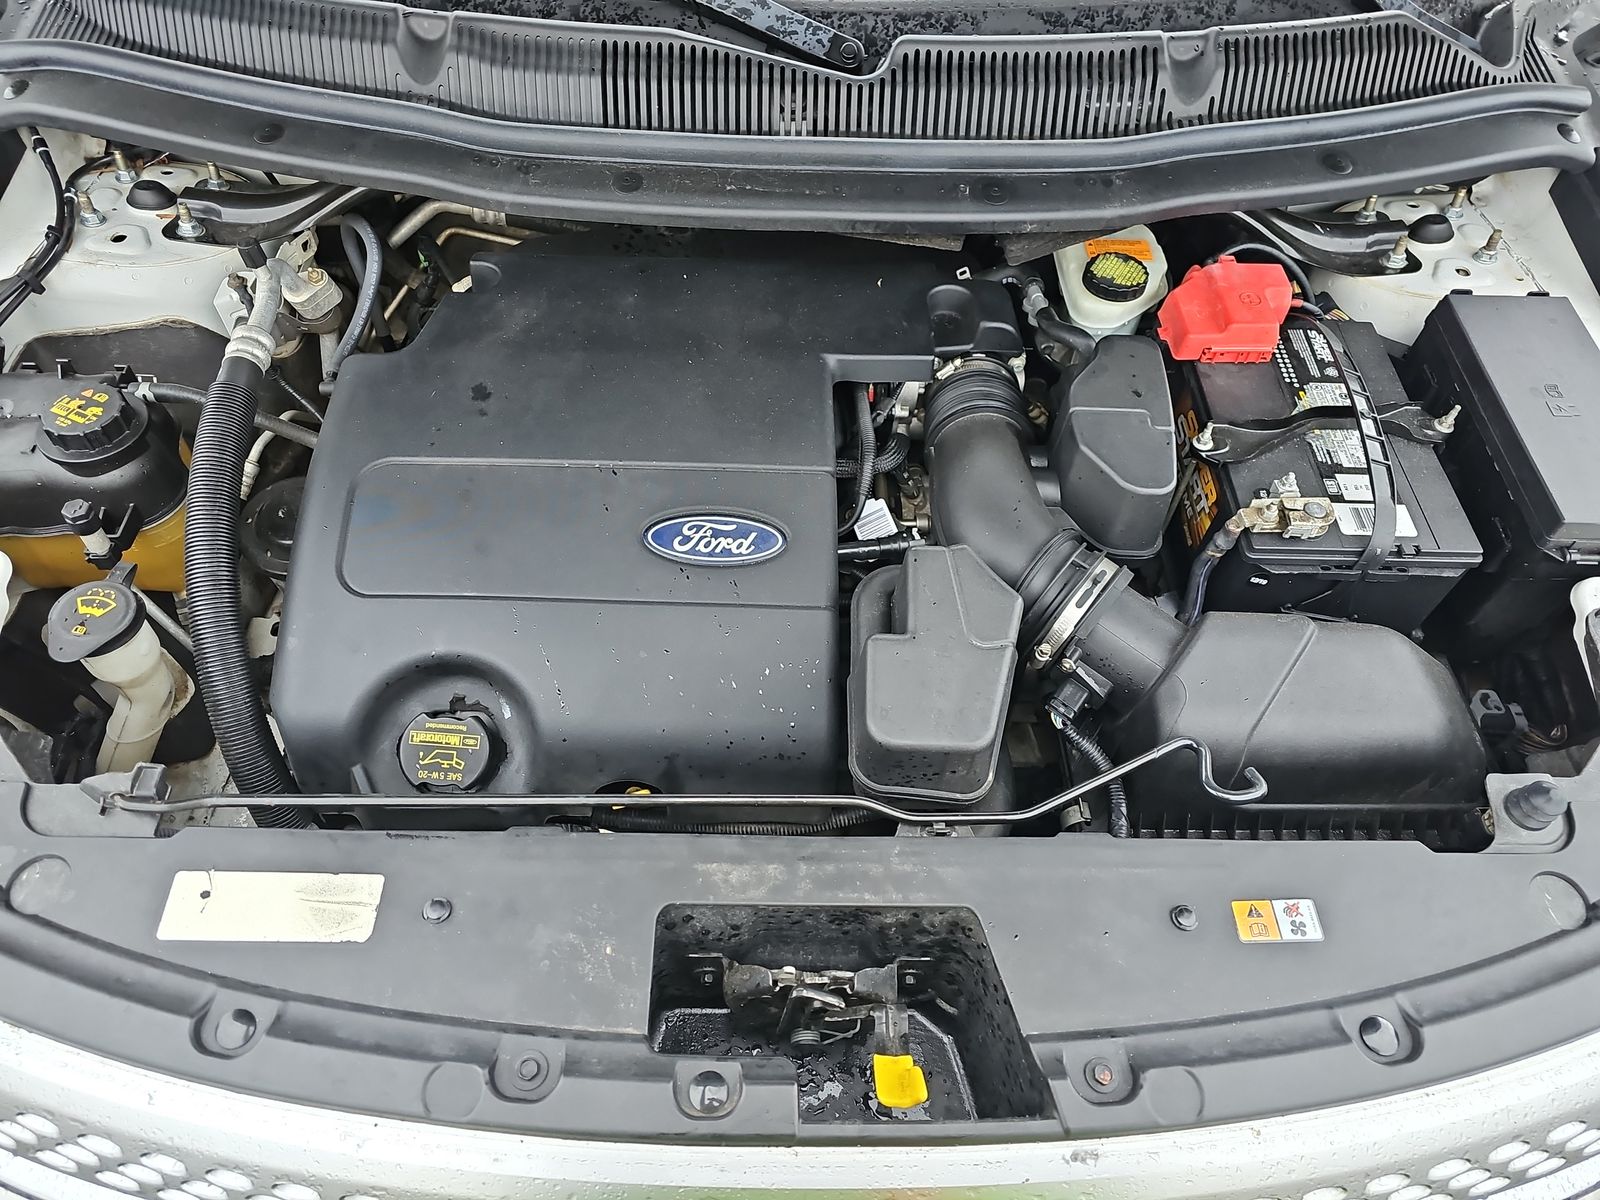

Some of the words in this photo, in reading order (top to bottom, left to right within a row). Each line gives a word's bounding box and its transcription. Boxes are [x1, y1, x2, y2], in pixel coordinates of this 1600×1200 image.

[1307, 329, 1329, 363] START
[673, 521, 758, 555] Ford
[426, 722, 467, 732] Recommended
[412, 732, 460, 746] Motorcraft
[446, 772, 463, 781] SAE
